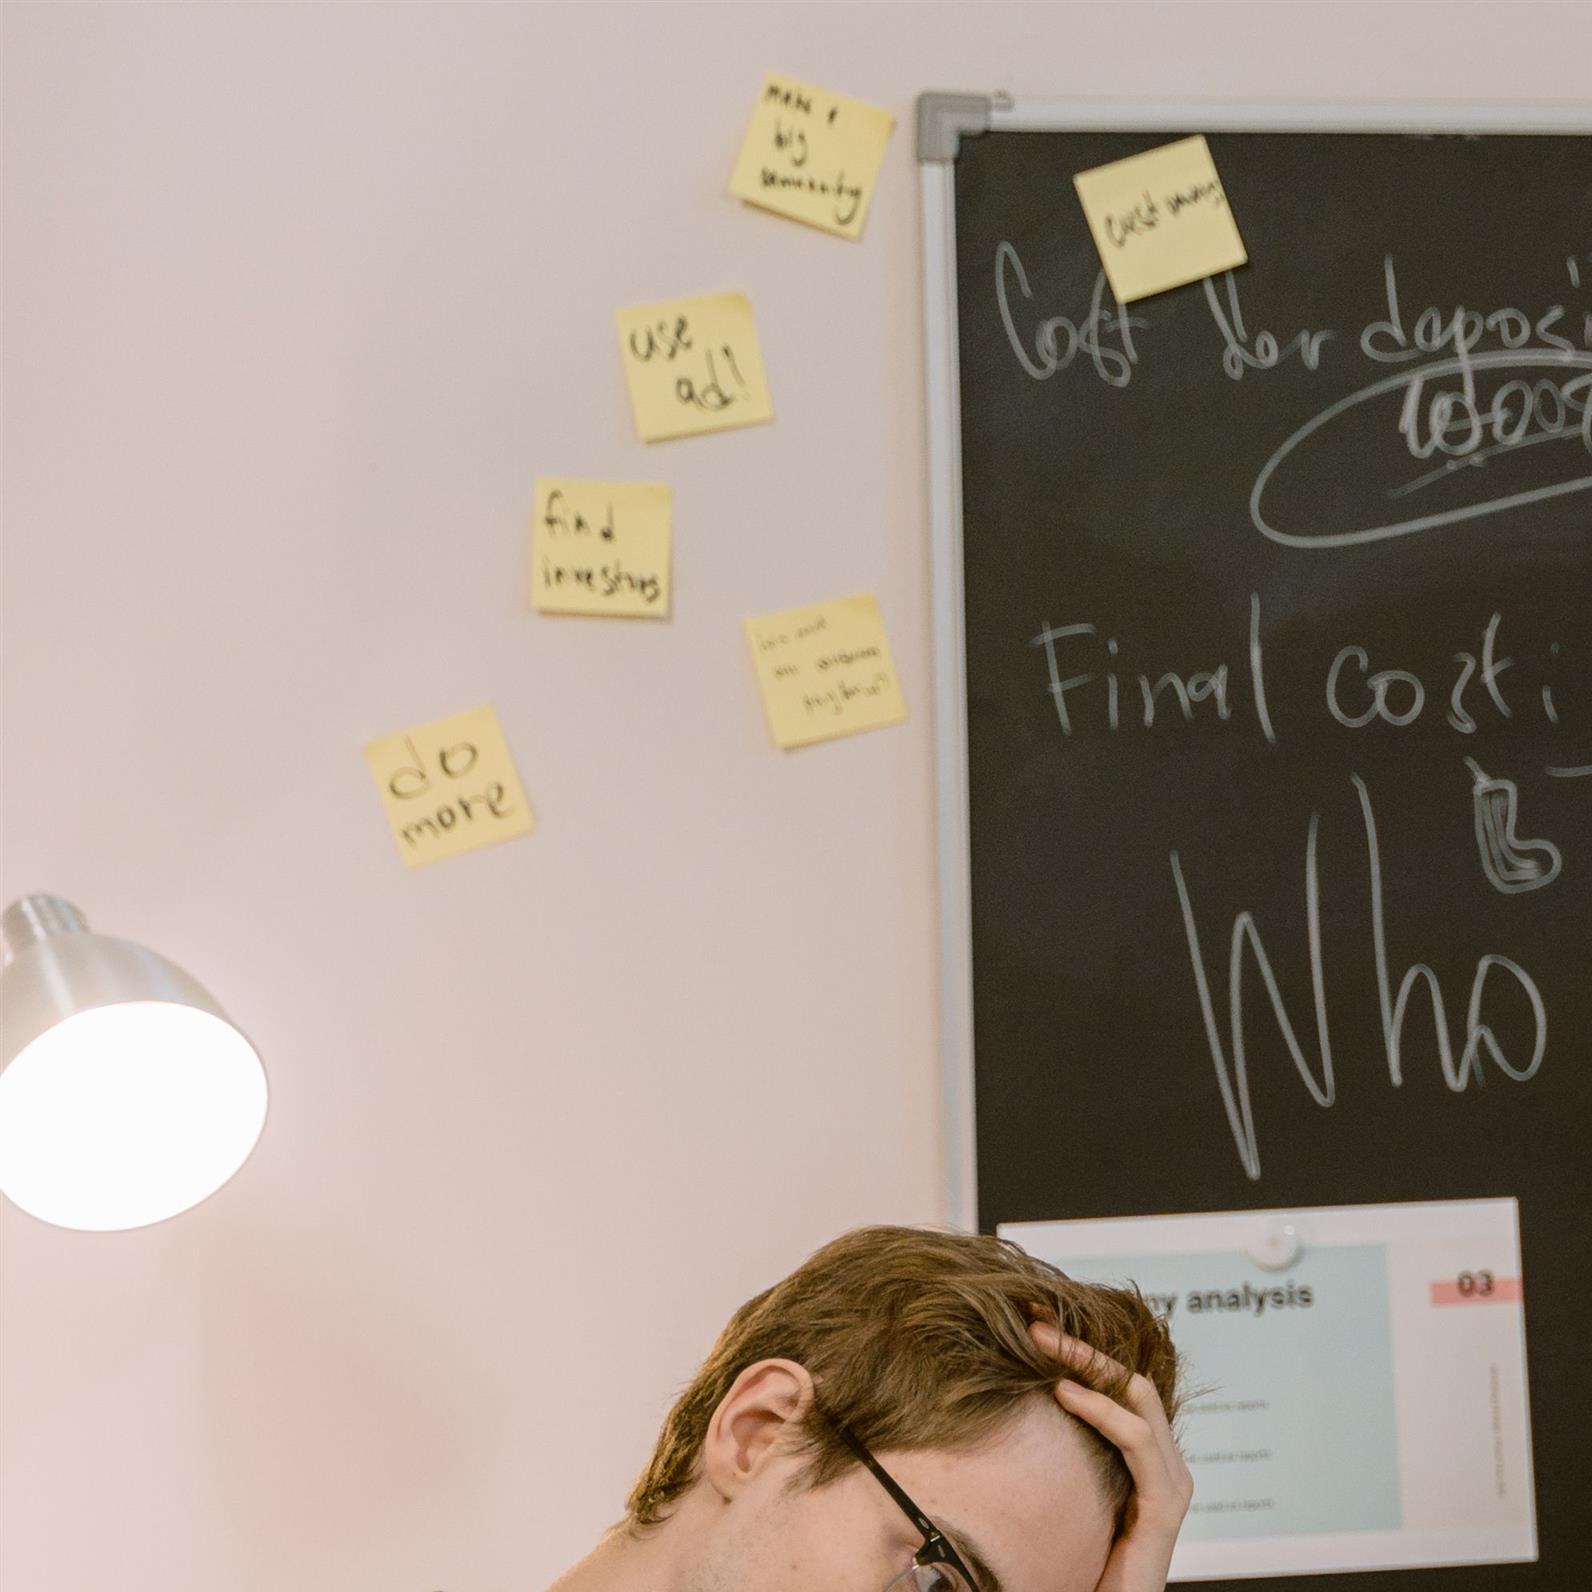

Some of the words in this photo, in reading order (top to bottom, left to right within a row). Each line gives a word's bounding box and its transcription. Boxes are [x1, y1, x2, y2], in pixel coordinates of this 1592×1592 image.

[628, 314, 694, 363] use
[1031, 593, 1277, 744] Final
[389, 734, 479, 801] do
[400, 778, 517, 848] more
[1170, 773, 1546, 1181] Who
[1186, 1279, 1315, 1319] analysis
[1457, 1270, 1495, 1298] 03
